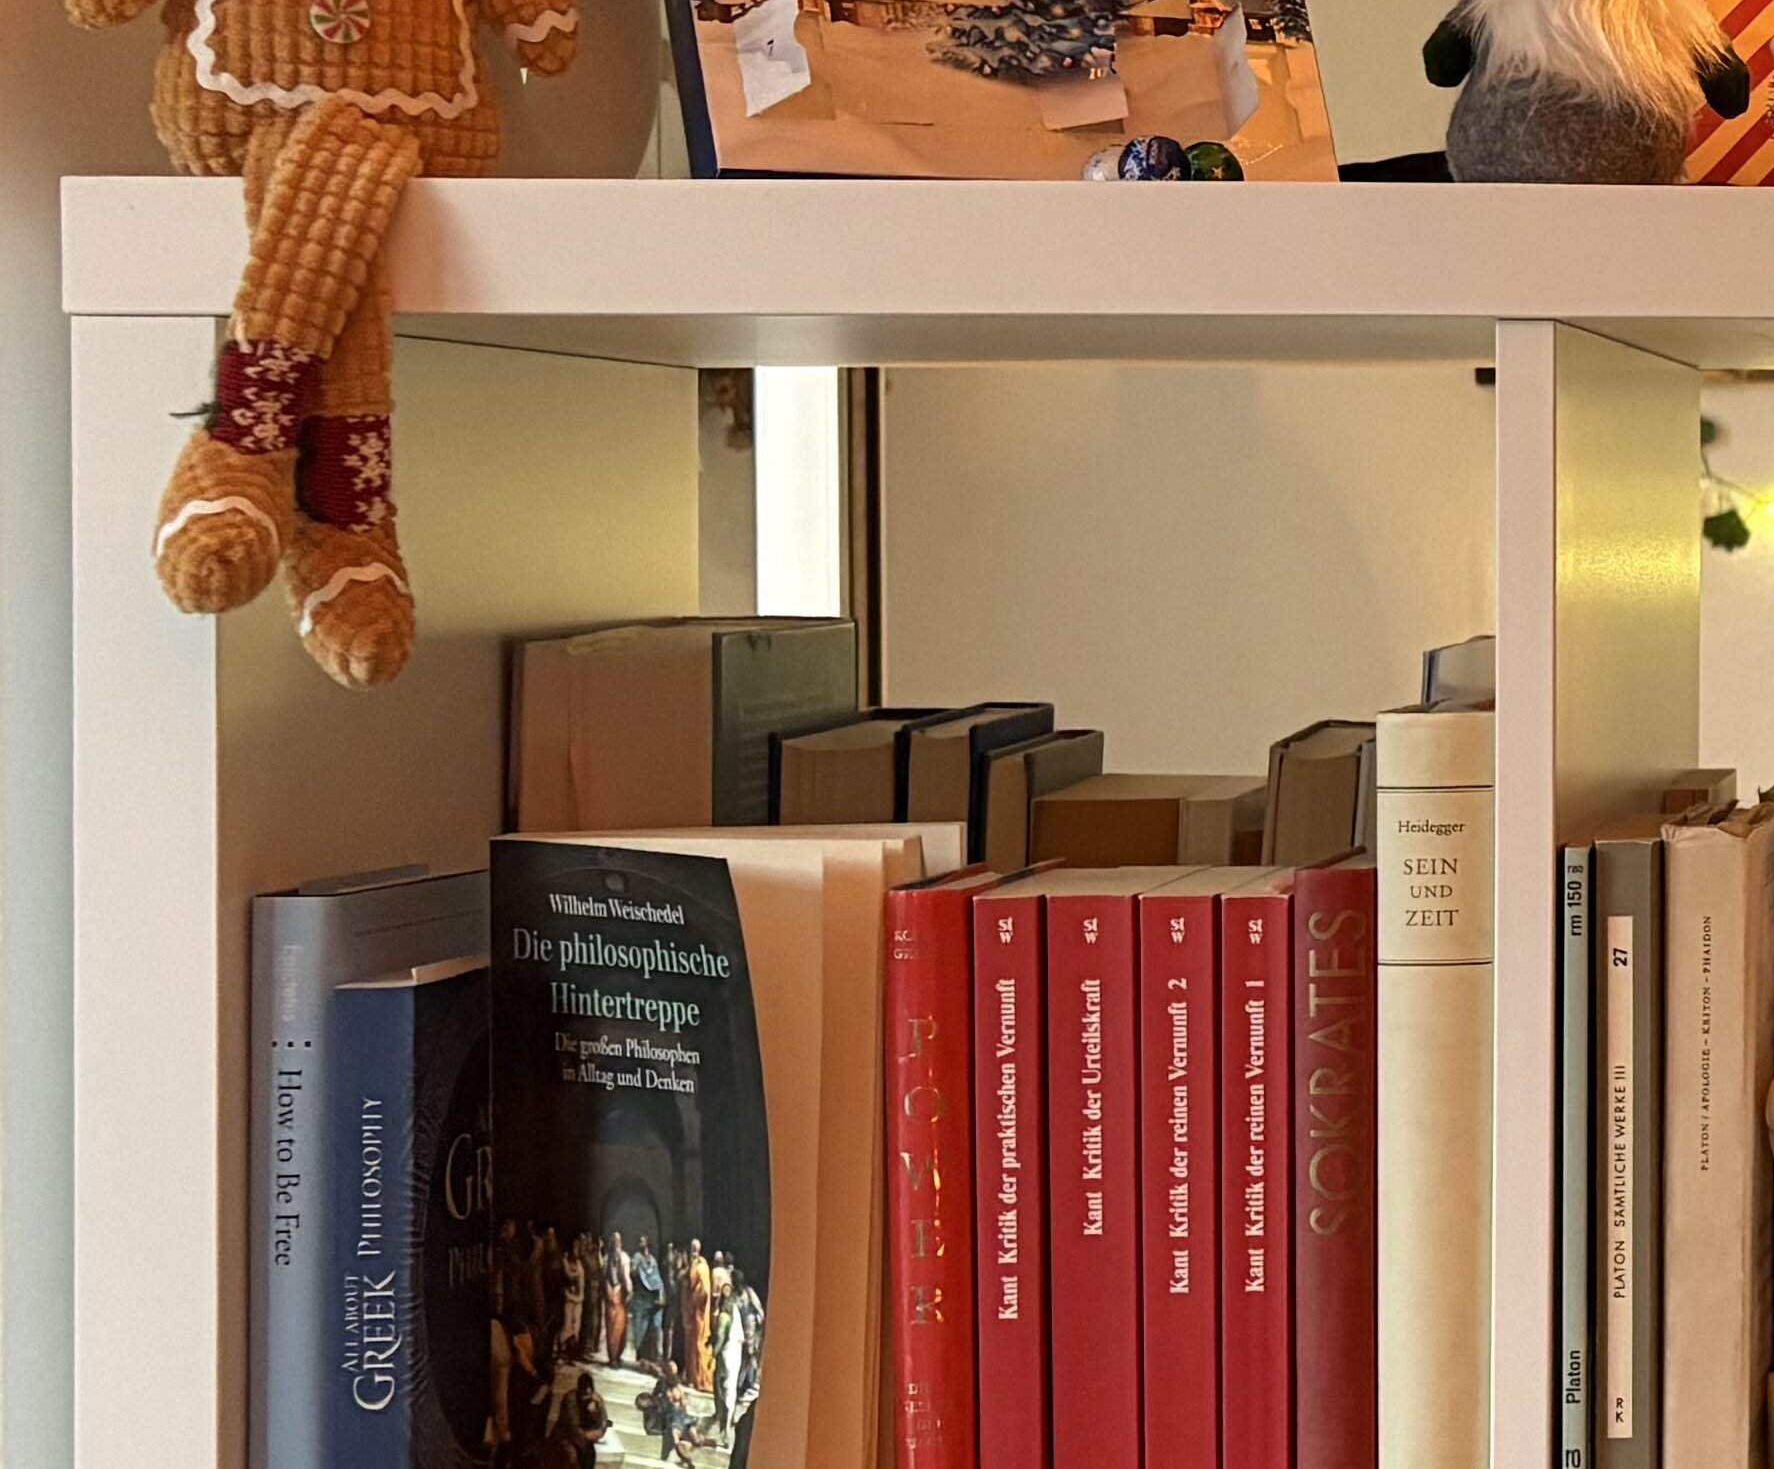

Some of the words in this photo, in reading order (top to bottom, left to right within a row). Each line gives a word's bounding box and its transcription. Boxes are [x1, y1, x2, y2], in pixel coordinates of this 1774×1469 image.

[1398, 819, 1466, 836] Heidegger
[1403, 858, 1458, 875] SEIN
[1410, 884, 1453, 898] UND
[549, 893, 607, 918] Wilhelm
[608, 898, 684, 925] Weischedel
[1405, 909, 1460, 926] ZEIT
[1567, 880, 1582, 908] 150
[1570, 914, 1582, 936] rm
[1702, 915, 1712, 974] PHAIDON
[513, 928, 552, 961] Die
[559, 932, 730, 979] philosophische
[1613, 948, 1628, 967] 27
[550, 981, 700, 1033] Hintertreppe
[1168, 977, 1188, 990] 2
[1245, 980, 1265, 988] 1
[995, 978, 1016, 1061] Vernunft
[1080, 978, 1102, 1086] Urteilskraft
[1701, 987, 1711, 1034] KRITON
[1168, 1001, 1188, 1081] Vernunft
[1245, 1000, 1265, 1079] Vernunft
[1308, 910, 1366, 1236] SOKRATES
[1614, 1065, 1626, 1079] III
[1701, 1048, 1711, 1111] APOLOGIE
[277, 1070, 302, 1131] How
[997, 1070, 1021, 1170] praktischen
[1082, 1090, 1102, 1121] der
[1168, 1085, 1188, 1144] reinen
[1245, 1084, 1265, 1142] reinen
[1614, 1086, 1626, 1138] WERKE
[277, 1138, 295, 1162] to
[1082, 1127, 1102, 1180] Kritik
[1169, 1147, 1189, 1179] der
[1245, 1146, 1265, 1178] der
[1700, 1124, 1710, 1171] PLATON
[276, 1173, 300, 1204] Be
[357, 1097, 383, 1258] PHILOSOPHY
[997, 1174, 1017, 1206] der
[1614, 1143, 1626, 1227] SÄMTLICHE
[1083, 1191, 1103, 1235] Kant
[1169, 1182, 1189, 1238] Kritik
[1245, 1181, 1265, 1237] Kritik
[274, 1213, 299, 1266] Free
[998, 1209, 1018, 1265] Kritik
[1170, 1249, 1190, 1294] Kant
[1245, 1248, 1265, 1293] Kant
[1613, 1240, 1626, 1298] PLATON
[344, 1276, 359, 1333] ABOUT
[998, 1275, 1018, 1320] Kant
[353, 1270, 402, 1412] GREEK
[1566, 1350, 1581, 1405] Platon
